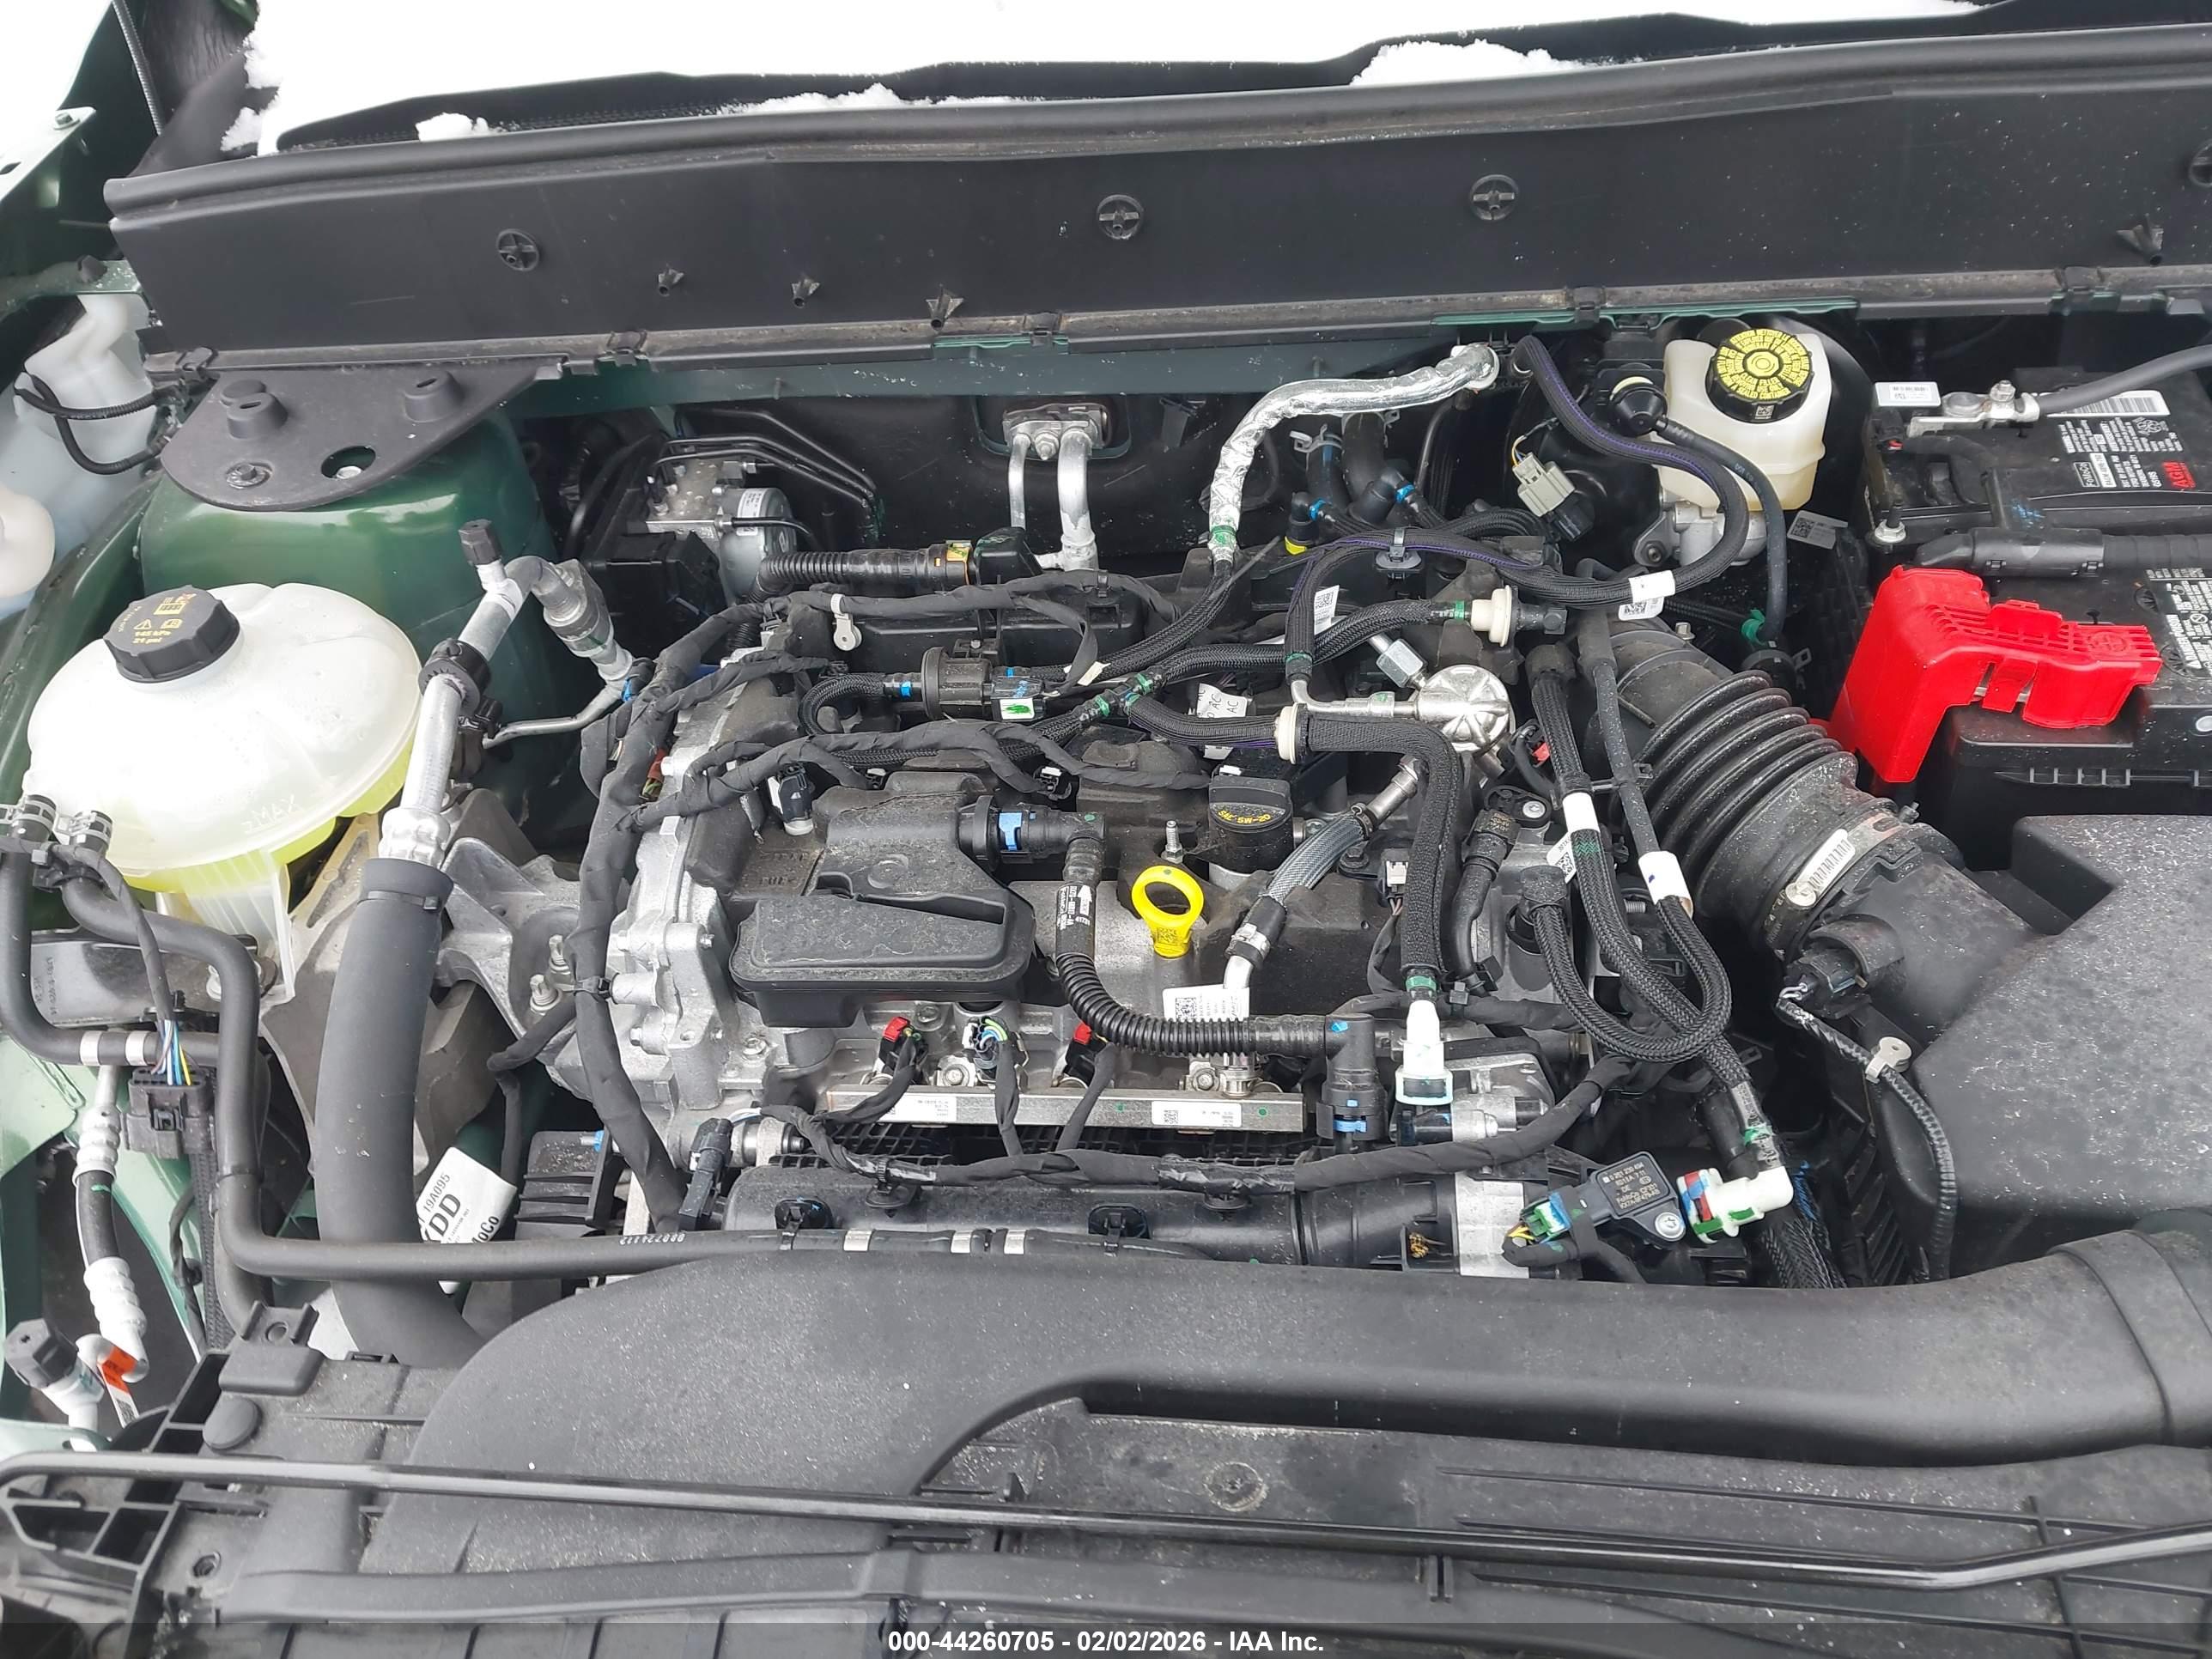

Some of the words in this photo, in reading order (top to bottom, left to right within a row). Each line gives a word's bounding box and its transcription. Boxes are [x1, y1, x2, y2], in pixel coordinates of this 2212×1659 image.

[1218, 810, 1235, 820] SAE
[1237, 813, 1271, 823] 5W-20
[423, 1174, 450, 1212] 19A095
